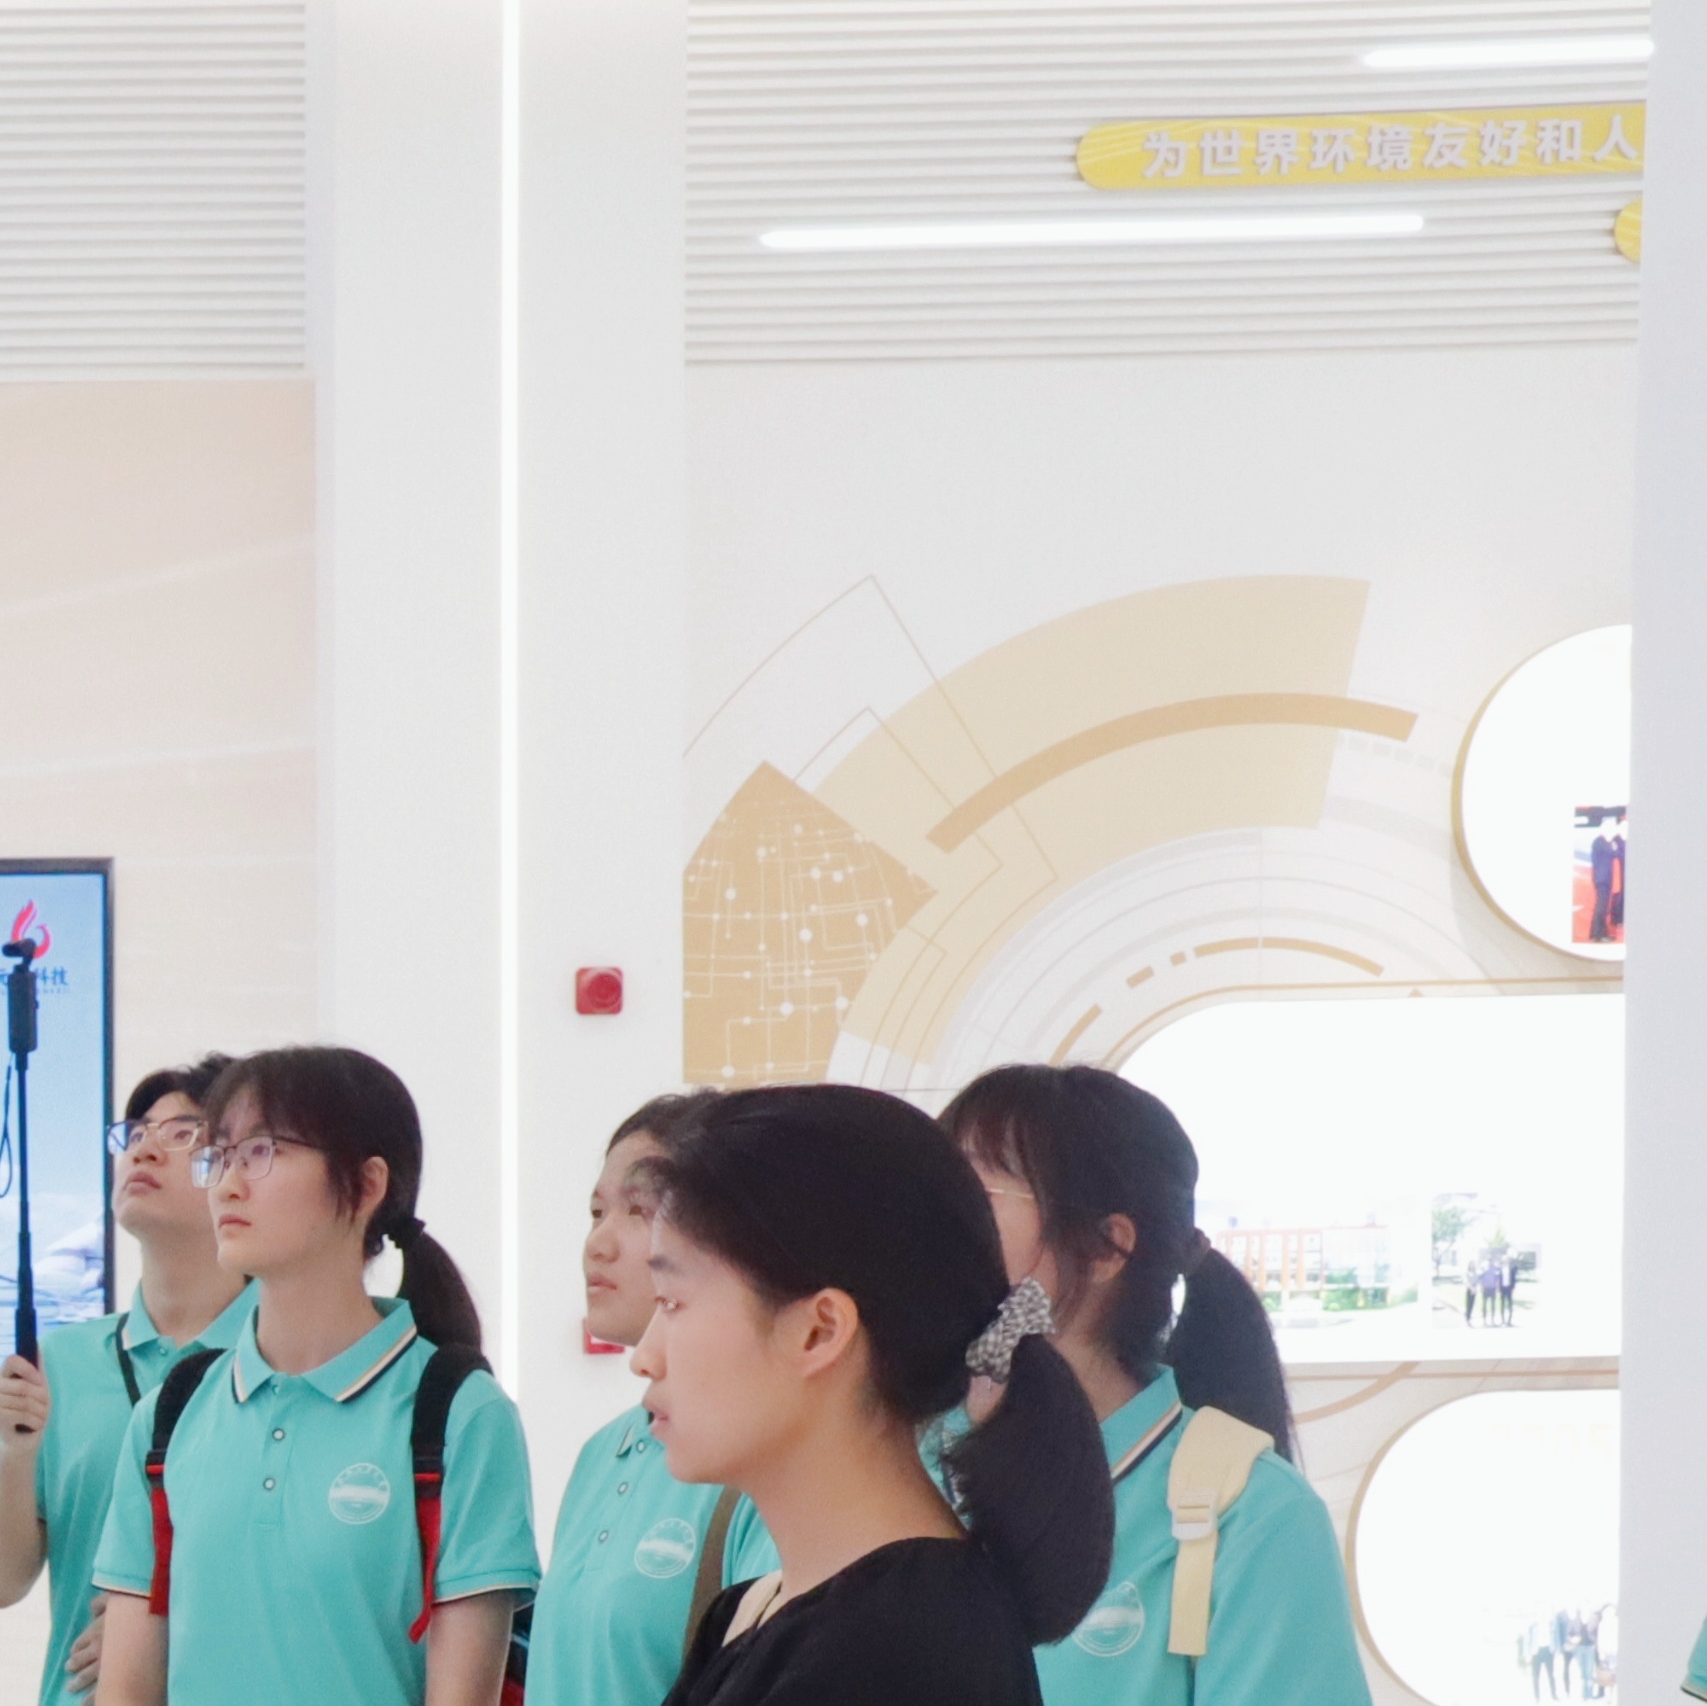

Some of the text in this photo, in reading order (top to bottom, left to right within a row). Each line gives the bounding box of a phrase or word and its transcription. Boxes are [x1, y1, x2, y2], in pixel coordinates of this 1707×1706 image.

[1143, 115, 1639, 179] 为世界环境友好和人
